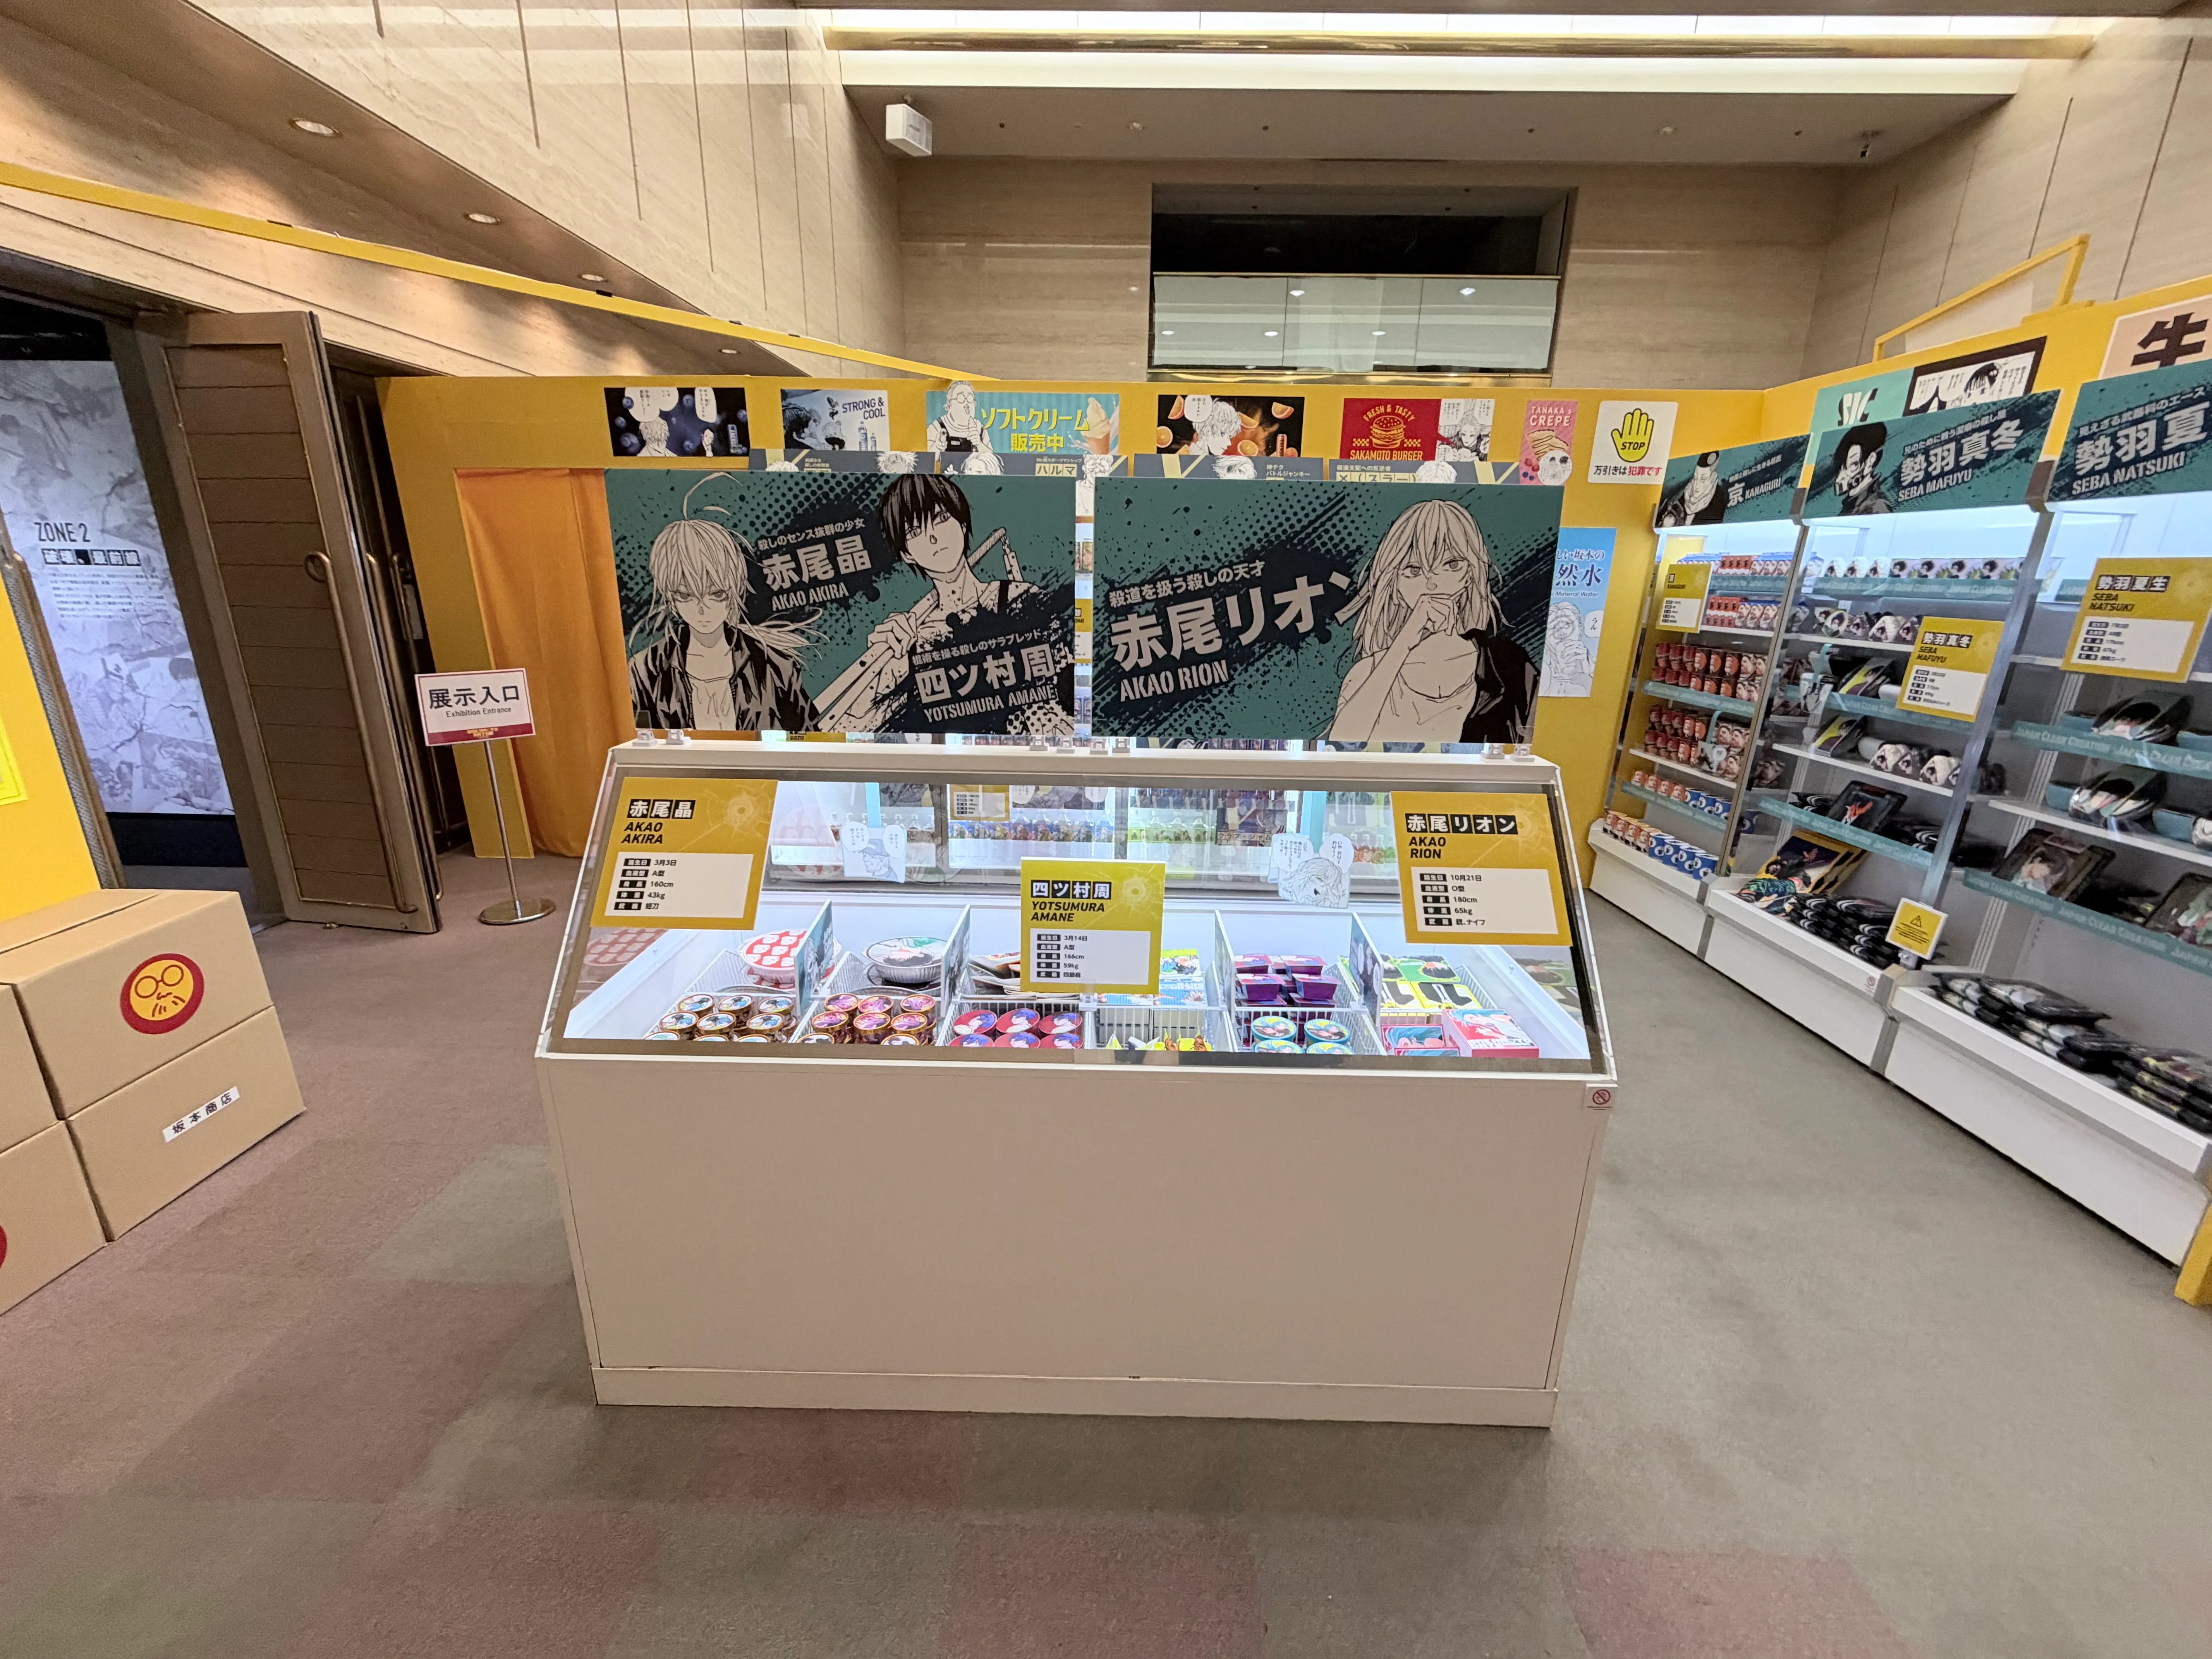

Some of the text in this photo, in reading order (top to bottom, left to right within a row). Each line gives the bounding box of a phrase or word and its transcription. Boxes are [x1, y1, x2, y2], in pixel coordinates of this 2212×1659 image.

[842, 397, 884, 413] STRONG &
[863, 407, 885, 420] COOL
[1363, 405, 1384, 422] FRESH
[1395, 405, 1415, 421] TASTY
[981, 408, 1090, 431] ソフトクリーム
[1530, 416, 1570, 426] CREPE
[1011, 433, 1064, 452] 販売中
[1621, 441, 1645, 450] STOP
[2075, 401, 2212, 475] 勢羽夏
[1350, 450, 1423, 460] SAKAMOTO BURGER
[1900, 419, 2023, 486] 勢羽真冬
[1037, 465, 1075, 475] ハルマ
[2072, 451, 2185, 495] SEBA NATSUKI
[1727, 477, 1781, 507] 京 KANAGURI
[1898, 469, 1972, 502] SEBA MAFUYU
[34, 522, 90, 542] ZONE 2
[757, 517, 865, 551] 殺しのセンス抜群の少女
[762, 534, 871, 591] 赤尾晶
[1109, 560, 1266, 608] 殺道を扱う殺しの天才
[1556, 564, 1602, 586] 然水
[2097, 576, 2169, 591] 勢羽夏生
[772, 582, 849, 611] AKAO AKIRA
[2089, 603, 2135, 612] NATSUKI
[1110, 571, 1371, 672] 赤尾リオン
[915, 643, 1055, 704] 四ツ村周
[1120, 660, 1229, 702] AKAO RION
[429, 686, 520, 709] 展示入口
[923, 685, 1056, 722] YOTSUMURA AMANE
[446, 709, 481, 718] Exhibition
[629, 800, 695, 818] 赤尾晶
[624, 822, 663, 832] AKAO
[1408, 815, 1515, 833] 赤尾リオン
[621, 834, 663, 844] AKIRA
[1408, 836, 1446, 847] AKAO
[1410, 848, 1441, 859] RION
[1032, 882, 1110, 898] 四ツ村周
[1032, 901, 1105, 912] YOTSUMURA
[1030, 912, 1075, 922] AMANE
[172, 1092, 232, 1134] 坂本商店
